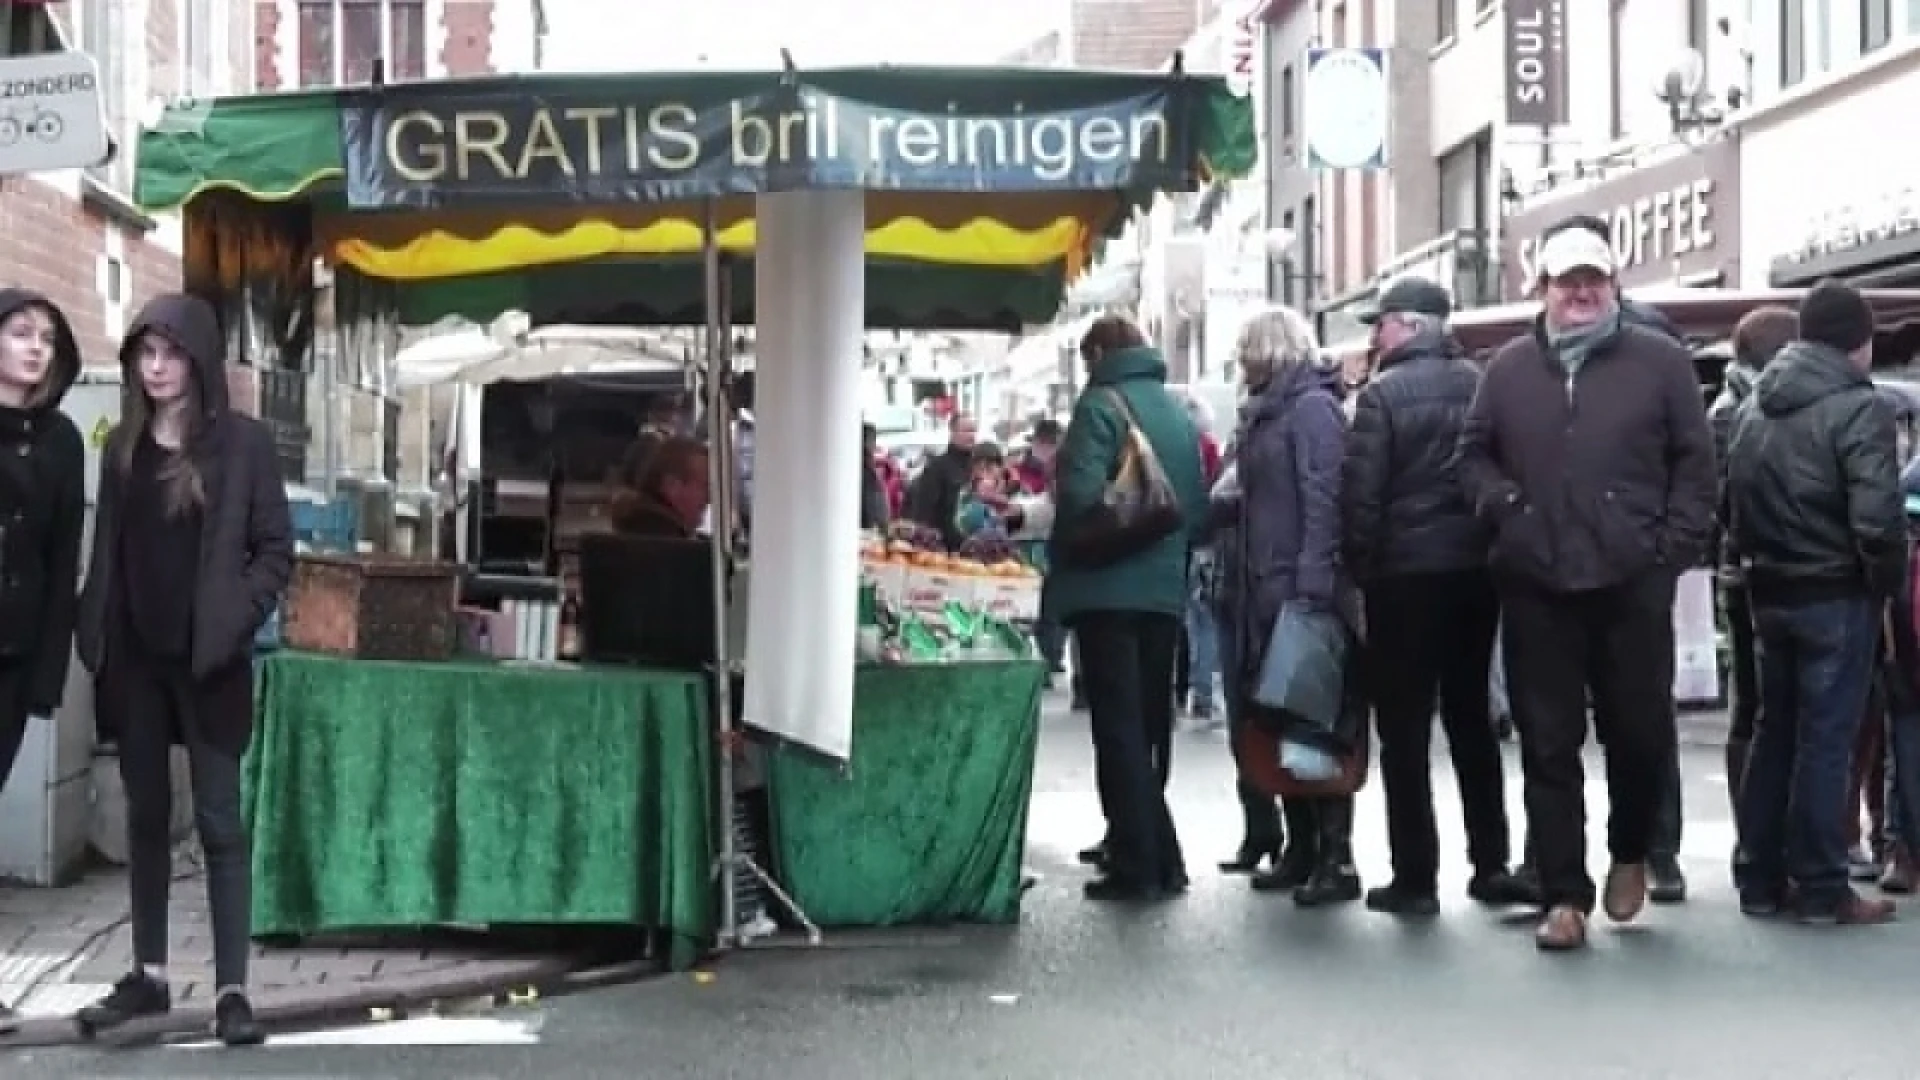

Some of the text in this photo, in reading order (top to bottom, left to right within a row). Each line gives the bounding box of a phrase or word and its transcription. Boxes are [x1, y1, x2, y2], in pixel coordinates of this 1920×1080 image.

[1515, 8, 1544, 103] SOUL
[385, 98, 1168, 182] GRATIS bril reinigen
[1598, 178, 1712, 271] OFFEE
